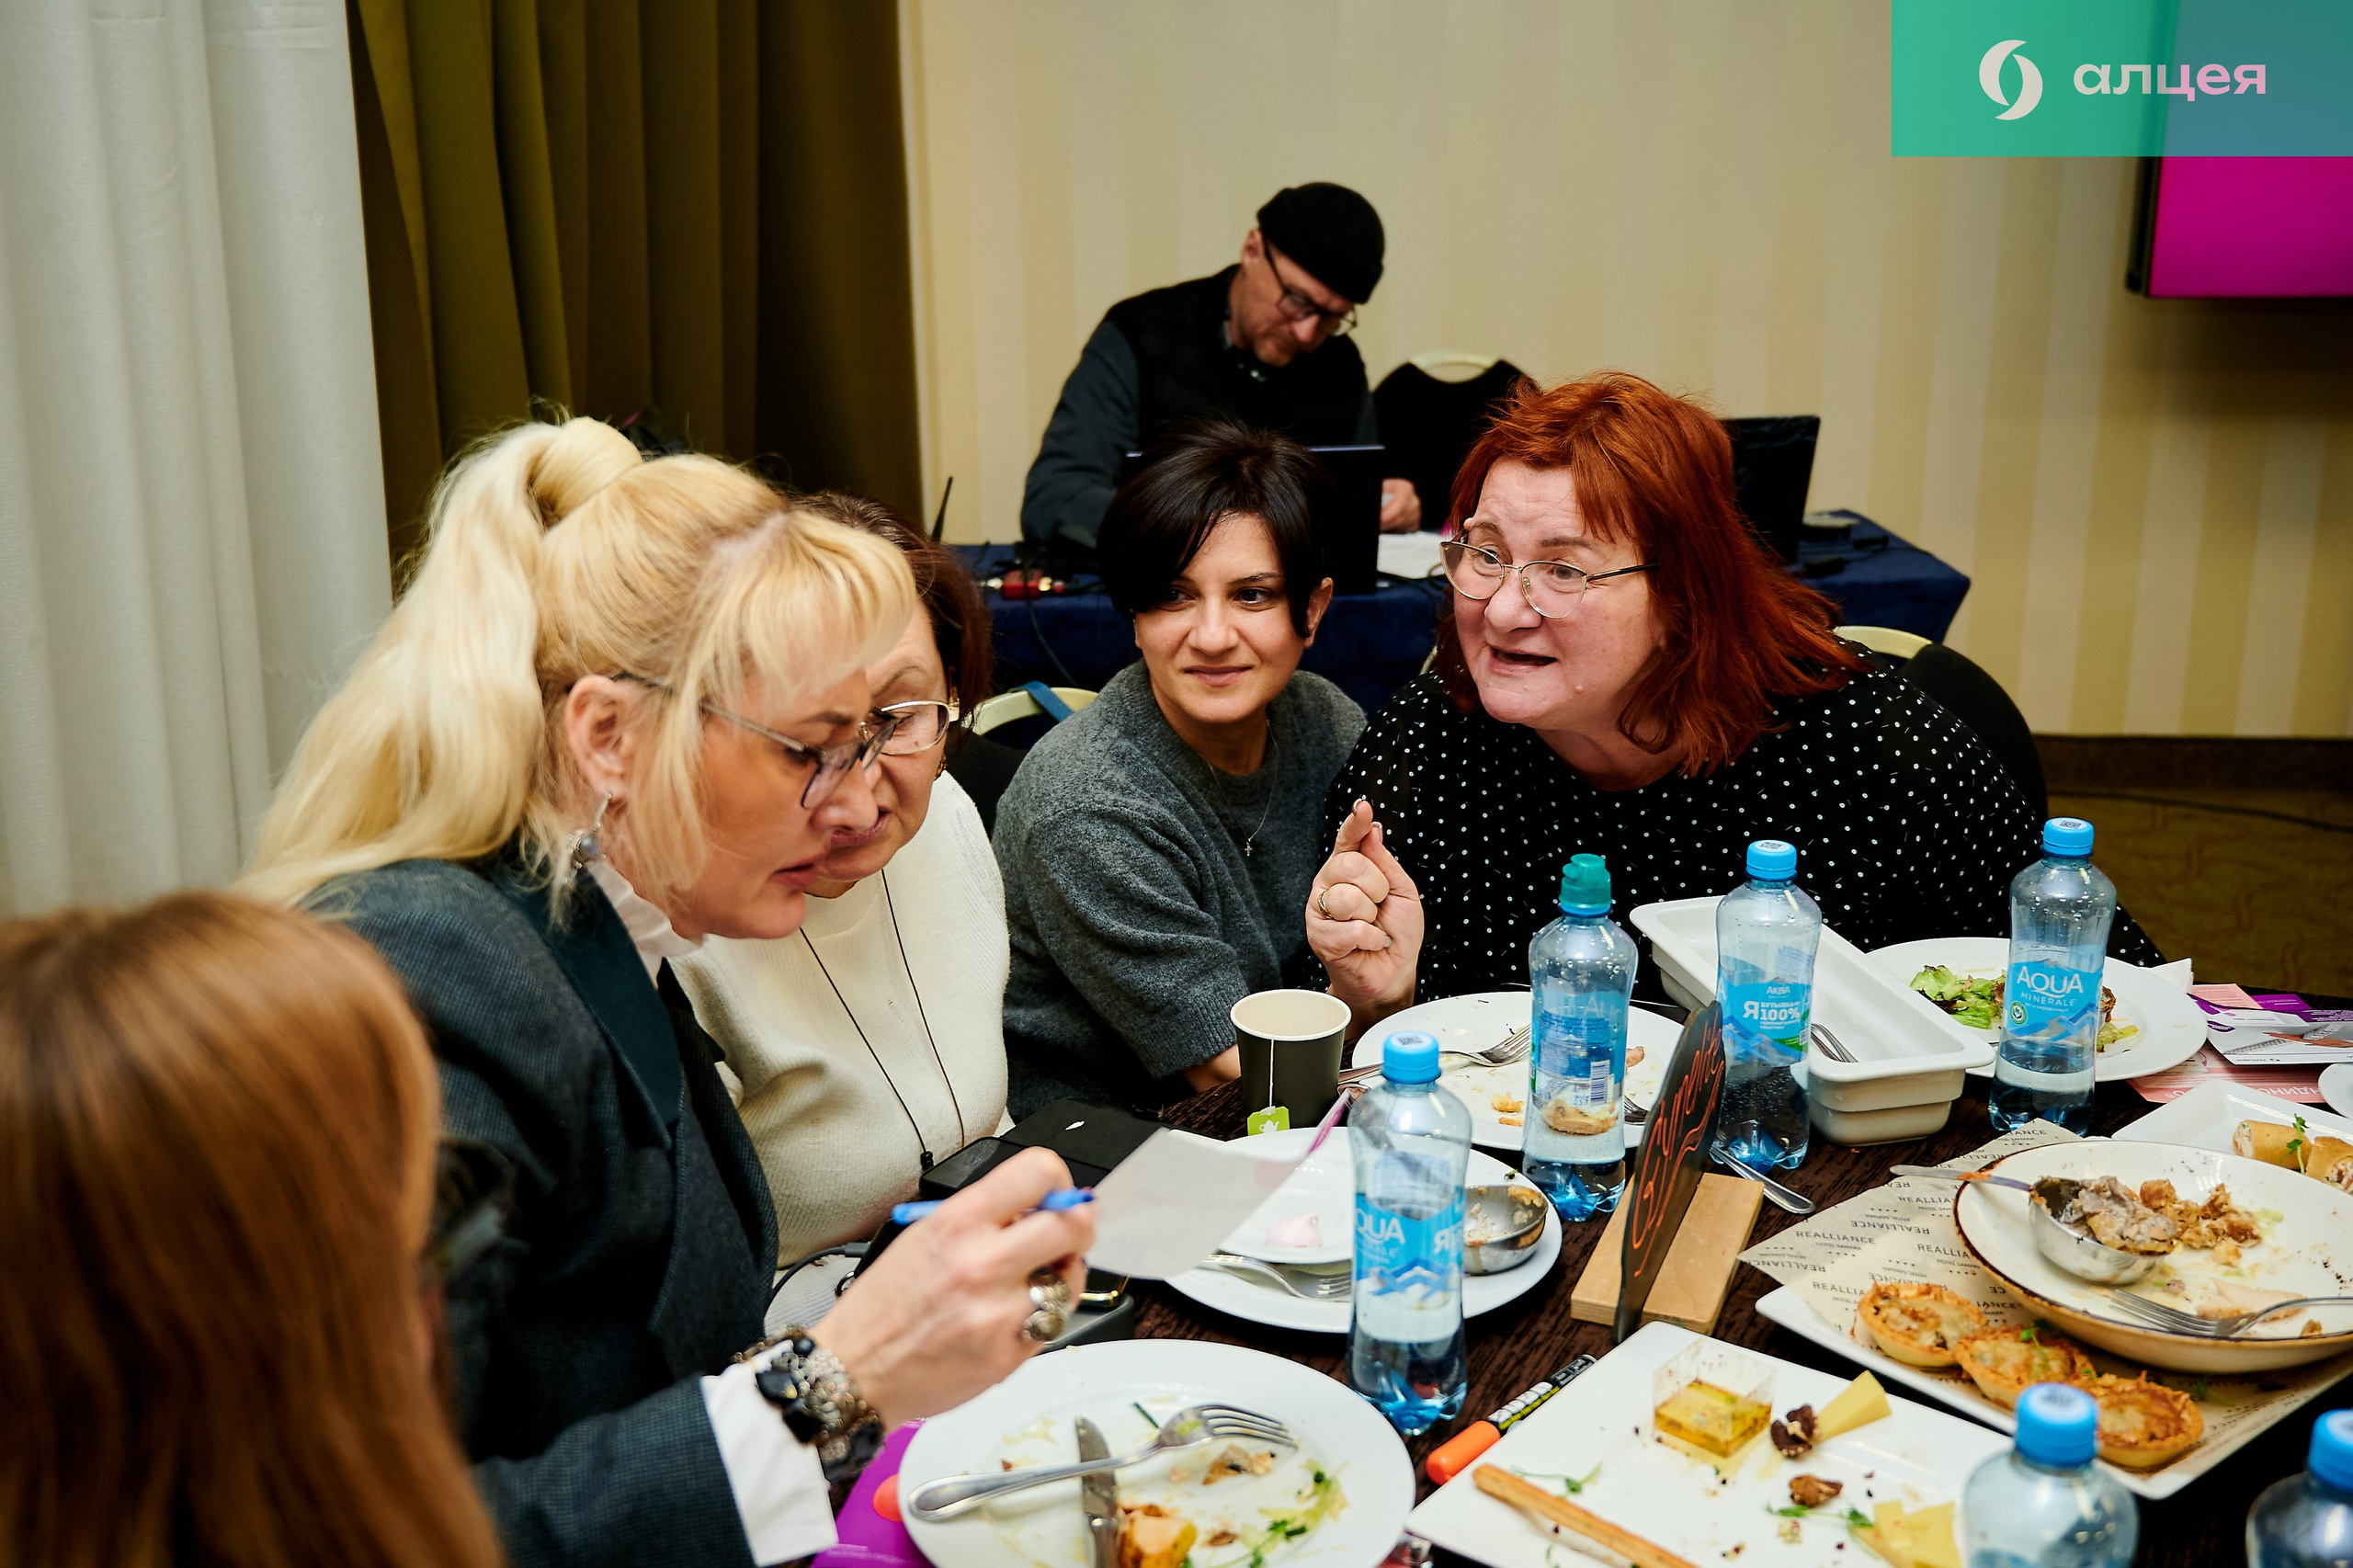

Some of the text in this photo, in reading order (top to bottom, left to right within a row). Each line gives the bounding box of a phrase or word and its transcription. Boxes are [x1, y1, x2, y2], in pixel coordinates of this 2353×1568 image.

[2017, 966, 2084, 998] AQUA
[1766, 986, 1790, 995] АКВА
[2020, 992, 2077, 1006] MINERALE
[1743, 1000, 1759, 1020] Я
[1760, 1008, 1801, 1021] 100%
[1898, 1196, 1952, 1204] REALLIA
[1356, 1208, 1406, 1244] QUA
[1850, 1220, 1930, 1234] REALLIANCE
[1795, 1231, 1876, 1244] REALLIANCE
[1917, 1244, 1970, 1258] REALLIA
[1813, 1281, 1865, 1296] REALLIA
